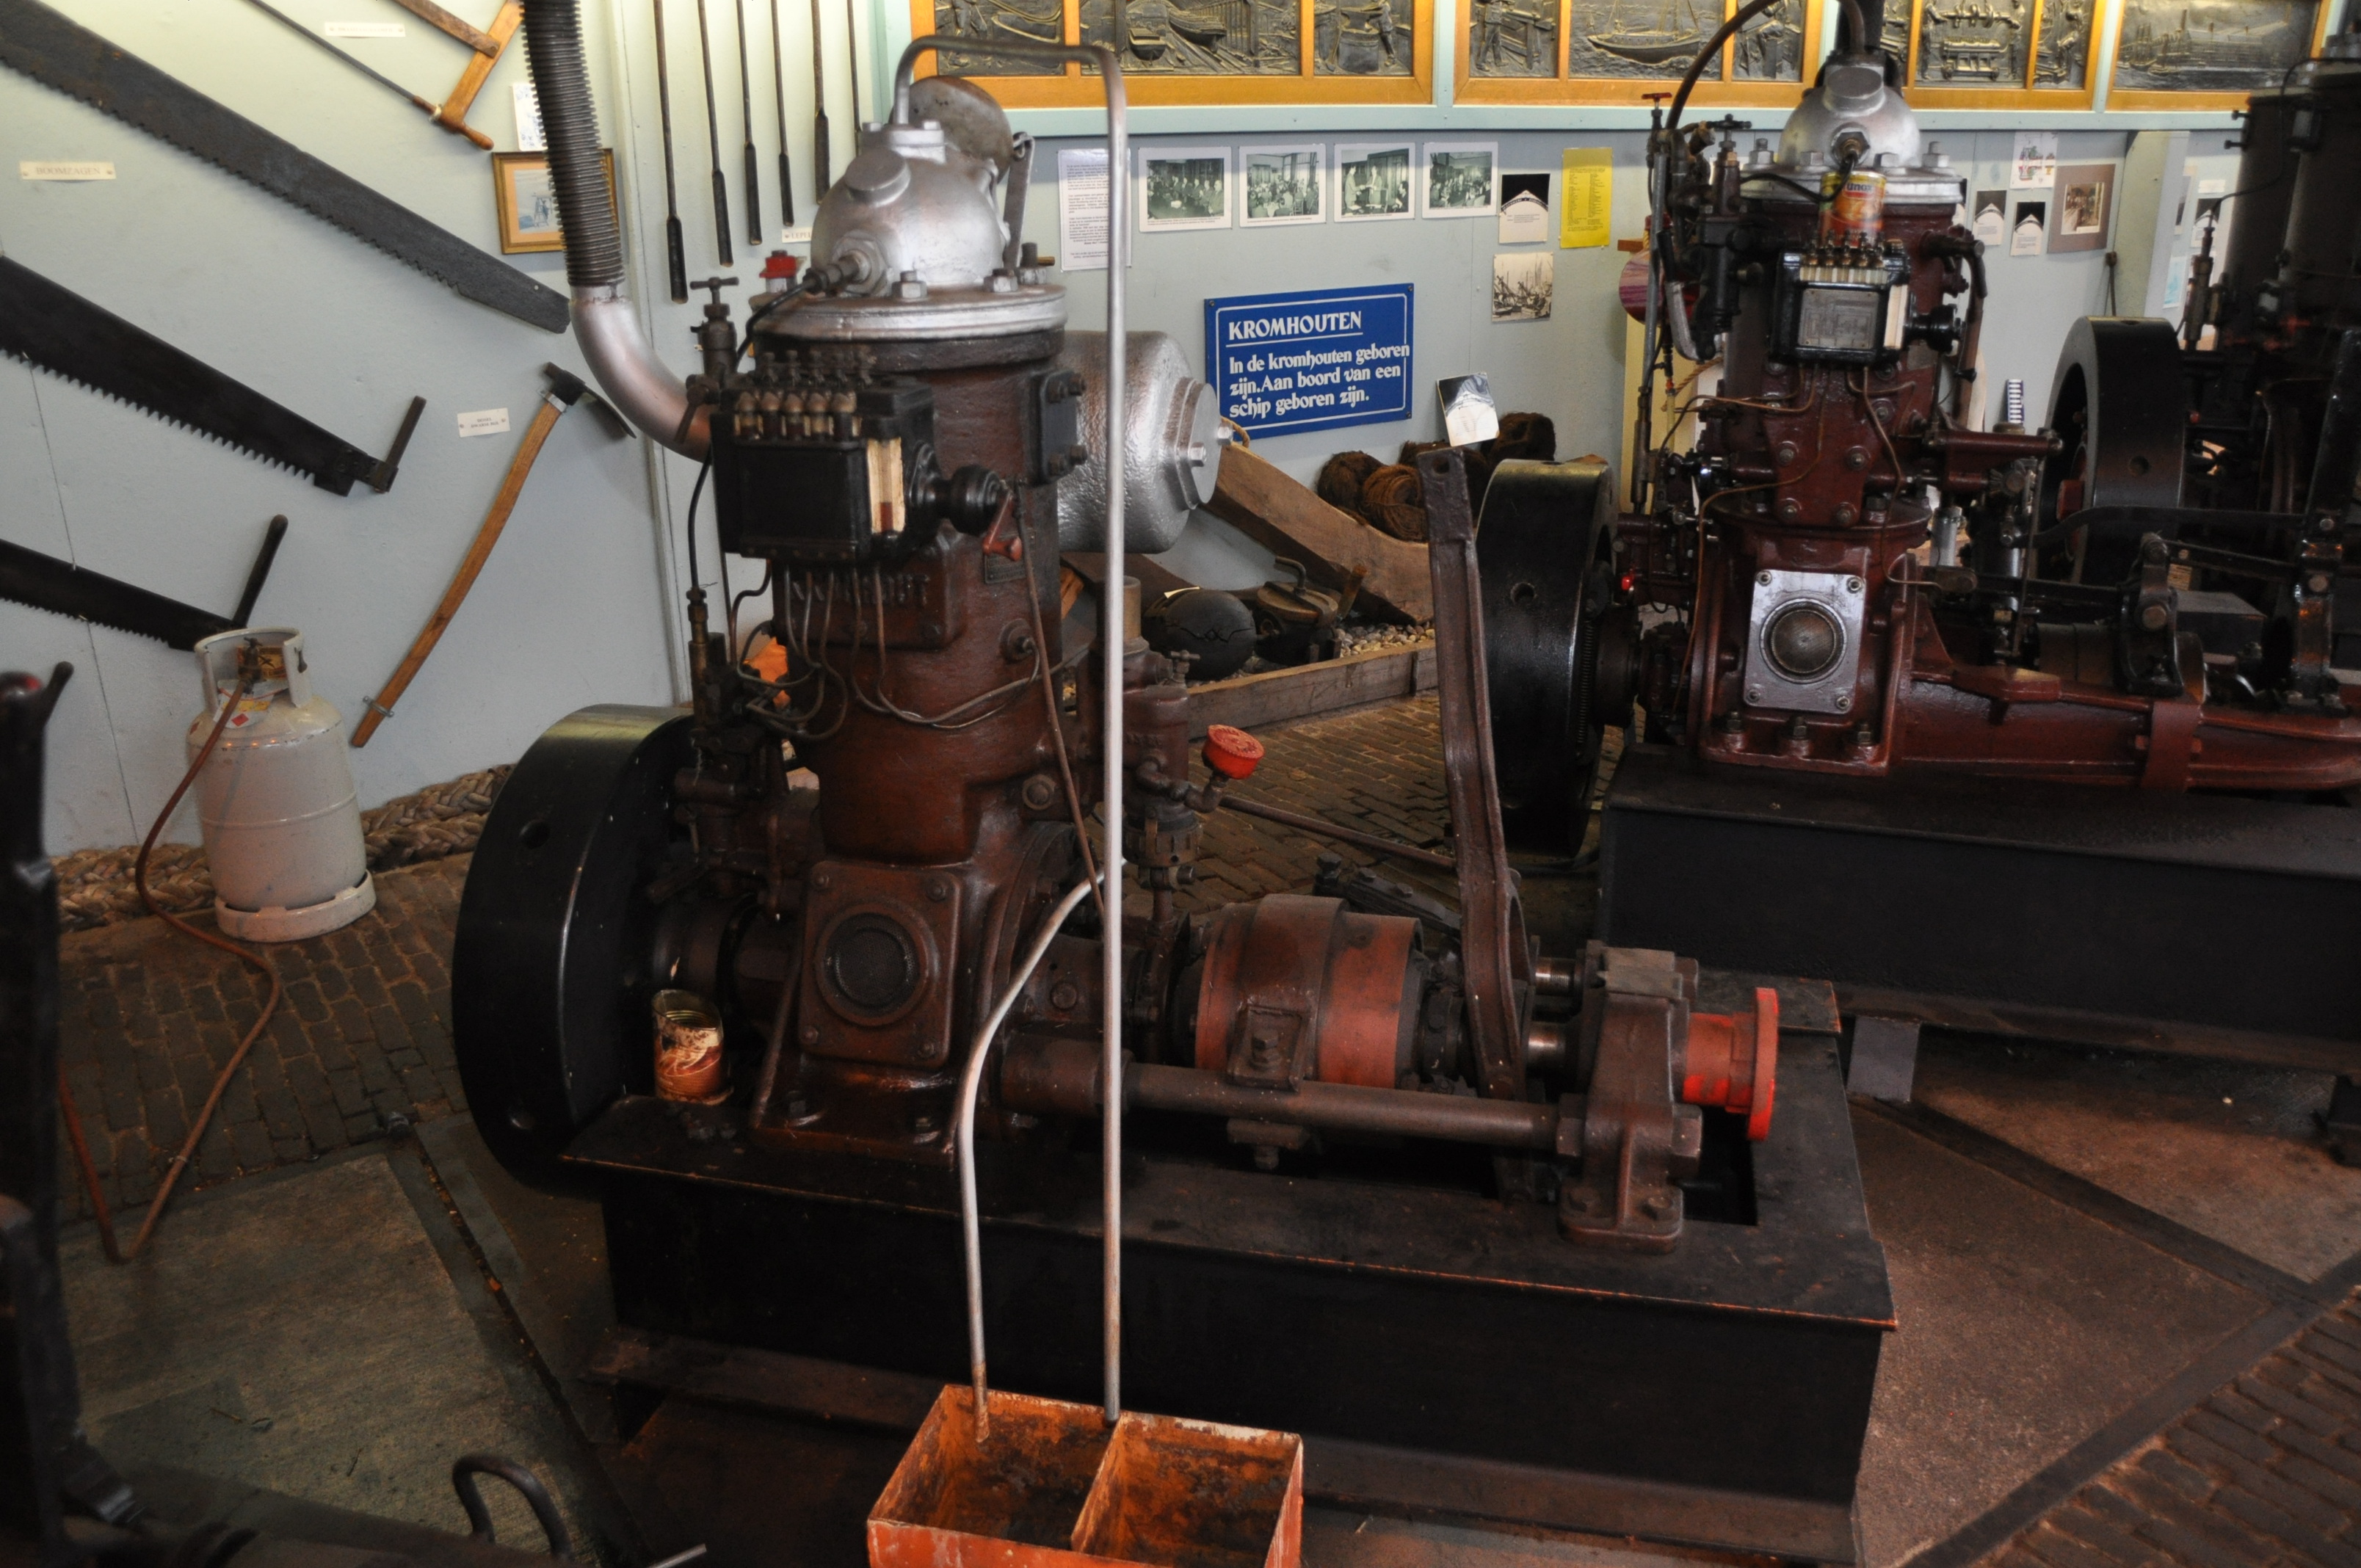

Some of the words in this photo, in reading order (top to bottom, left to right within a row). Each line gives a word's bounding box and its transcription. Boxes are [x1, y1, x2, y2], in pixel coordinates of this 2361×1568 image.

[35, 166, 101, 175] BOOMZAGEN
[1228, 311, 1362, 341] KROMHOUTEN
[1229, 356, 1244, 374] In
[1247, 354, 1265, 371] de
[1268, 349, 1352, 371] kromhouten
[1355, 343, 1410, 365] geboren
[1297, 367, 1341, 388] boord
[1343, 368, 1371, 382] van
[1375, 365, 1401, 379] een
[1229, 397, 1272, 419] schip
[1274, 392, 1335, 415] geboren
[1339, 385, 1370, 408] zijn.
